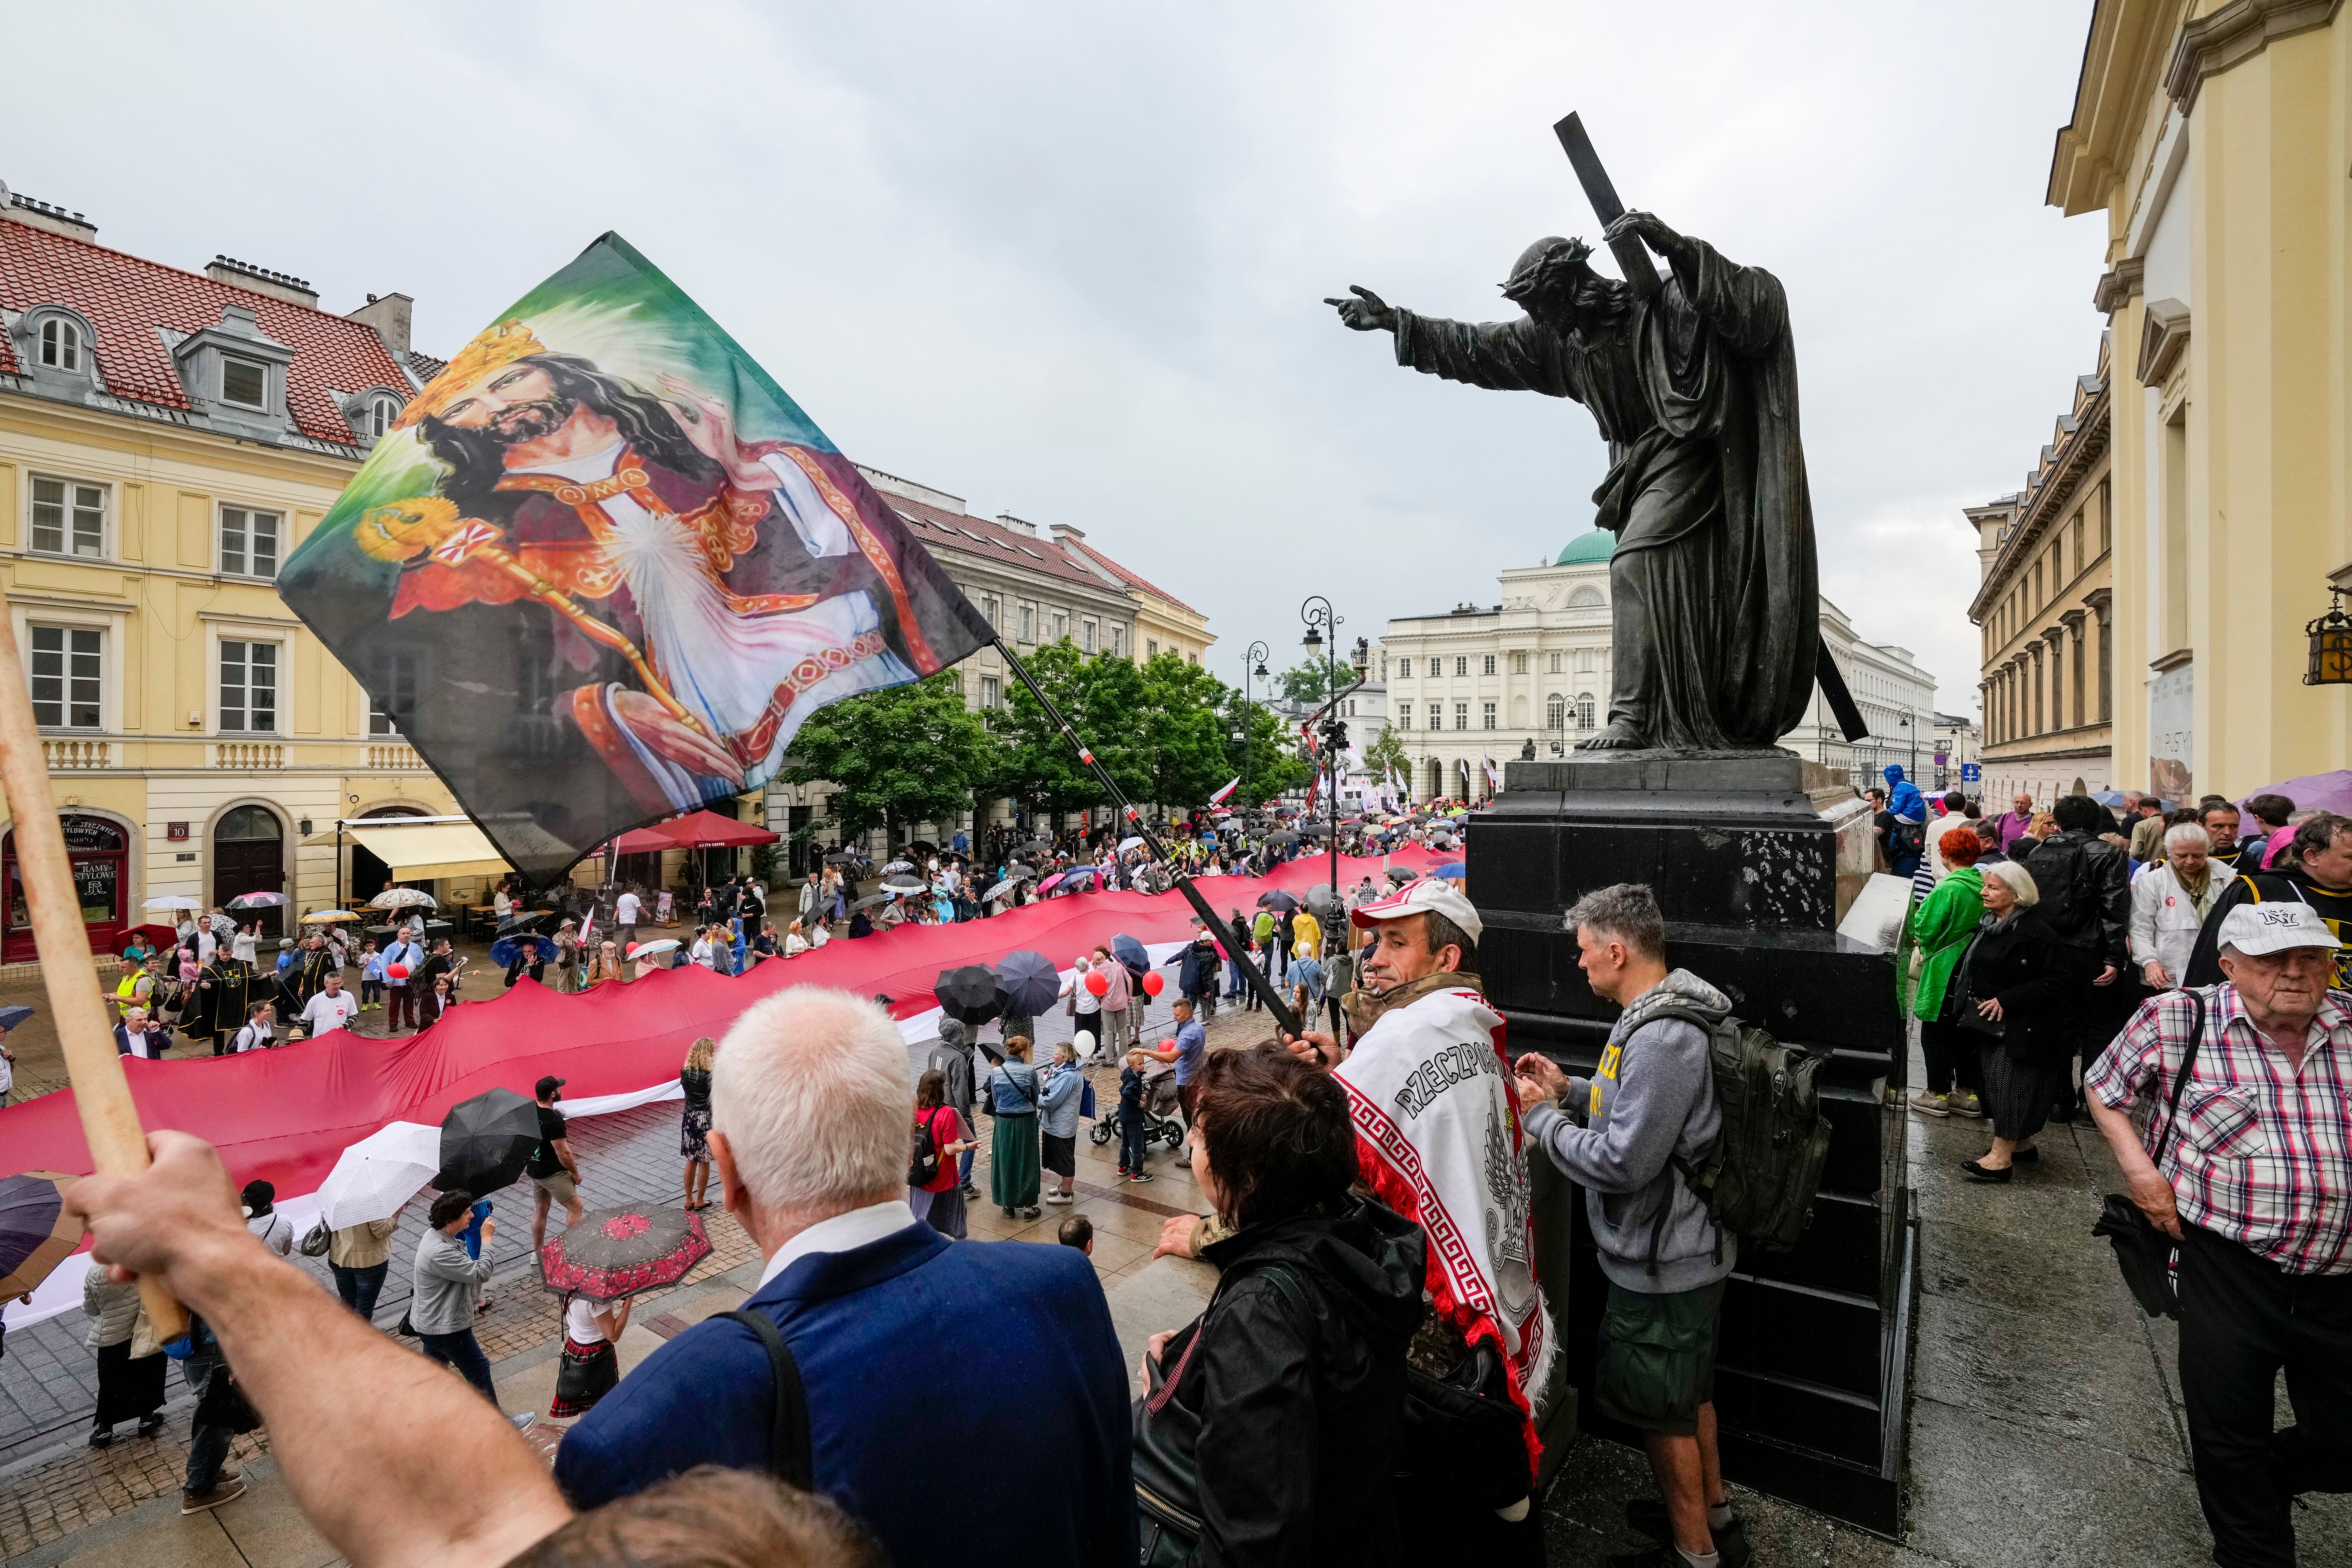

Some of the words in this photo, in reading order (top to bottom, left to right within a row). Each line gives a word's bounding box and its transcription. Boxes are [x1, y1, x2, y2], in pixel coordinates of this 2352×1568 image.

[62, 827, 98, 836] TYLOWYCH
[173, 828, 184, 836] 10
[82, 865, 109, 873] RAMY
[75, 871, 117, 880] STYLOWE
[2258, 908, 2300, 927] NY
